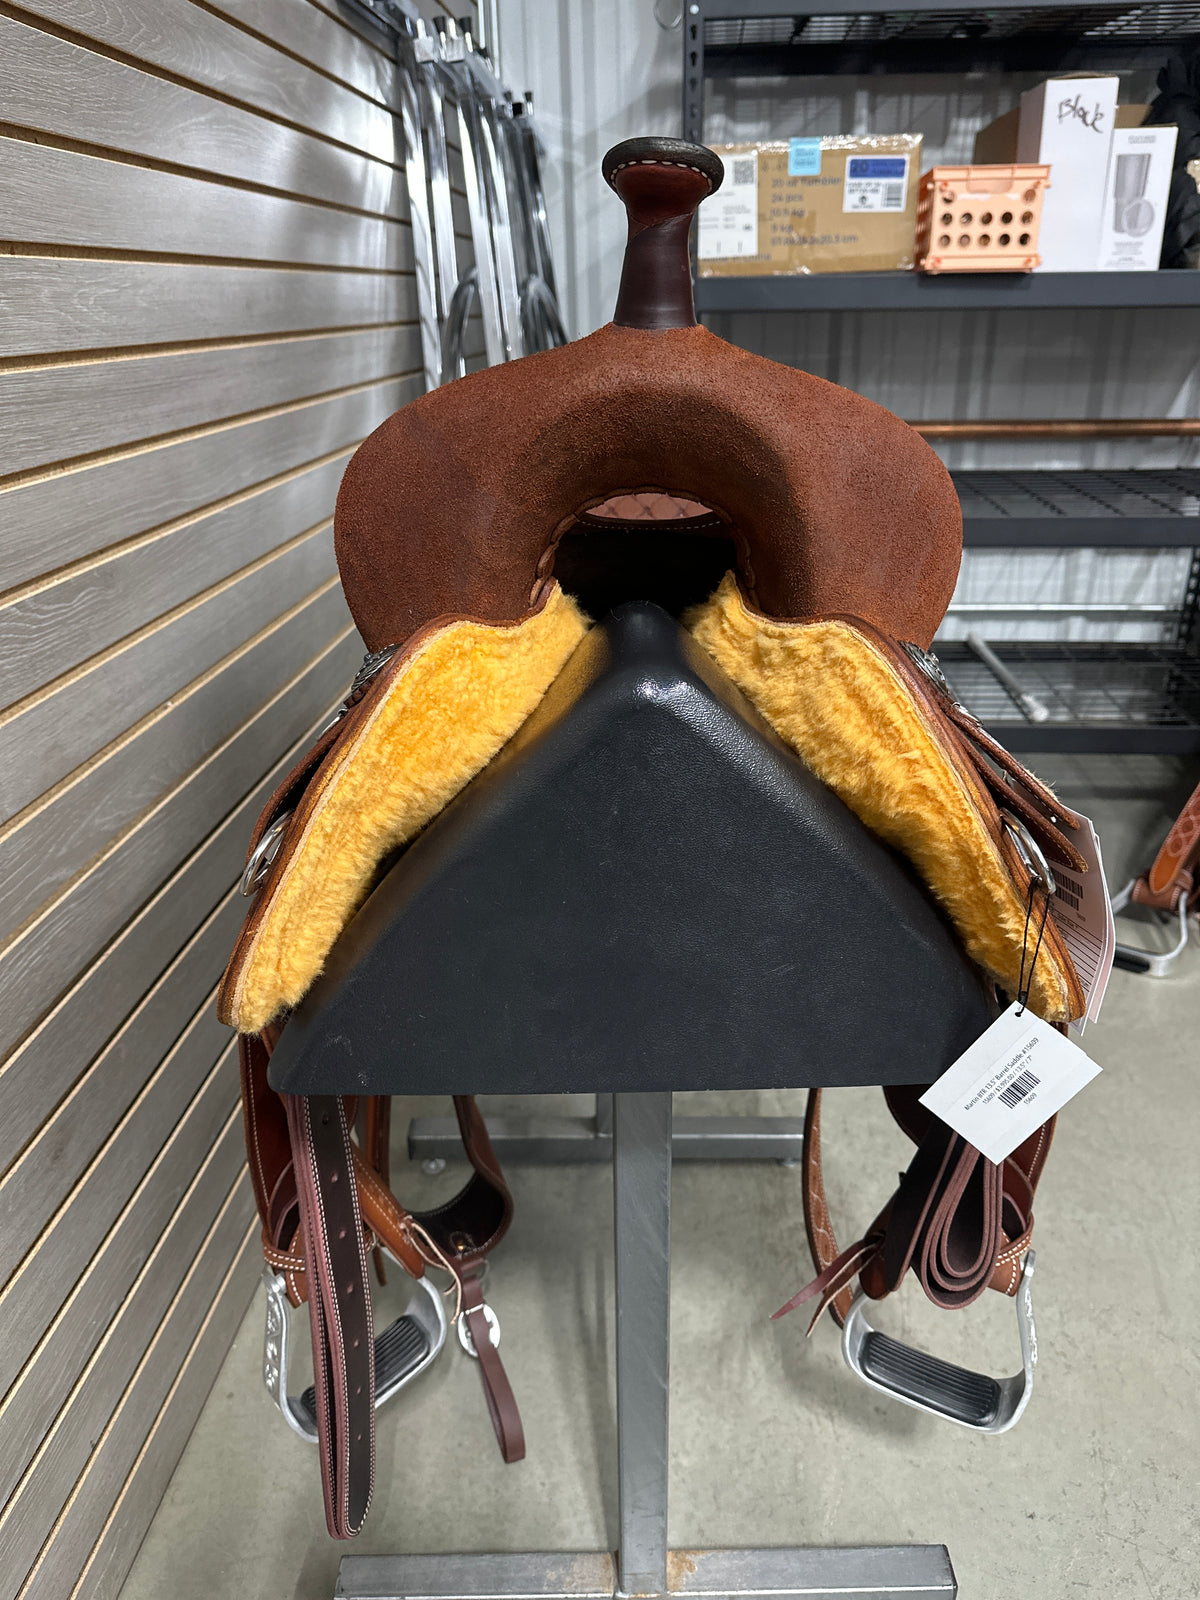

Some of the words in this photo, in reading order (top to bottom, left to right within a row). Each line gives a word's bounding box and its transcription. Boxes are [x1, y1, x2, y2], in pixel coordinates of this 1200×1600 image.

[964, 1096, 980, 1110] Martin
[977, 1088, 988, 1098] BTR
[995, 1065, 1010, 1080] Barrel
[1007, 1053, 1023, 1069] Saddle
[1022, 1037, 1039, 1054] #15609
[1023, 1092, 1038, 1105] 15609
